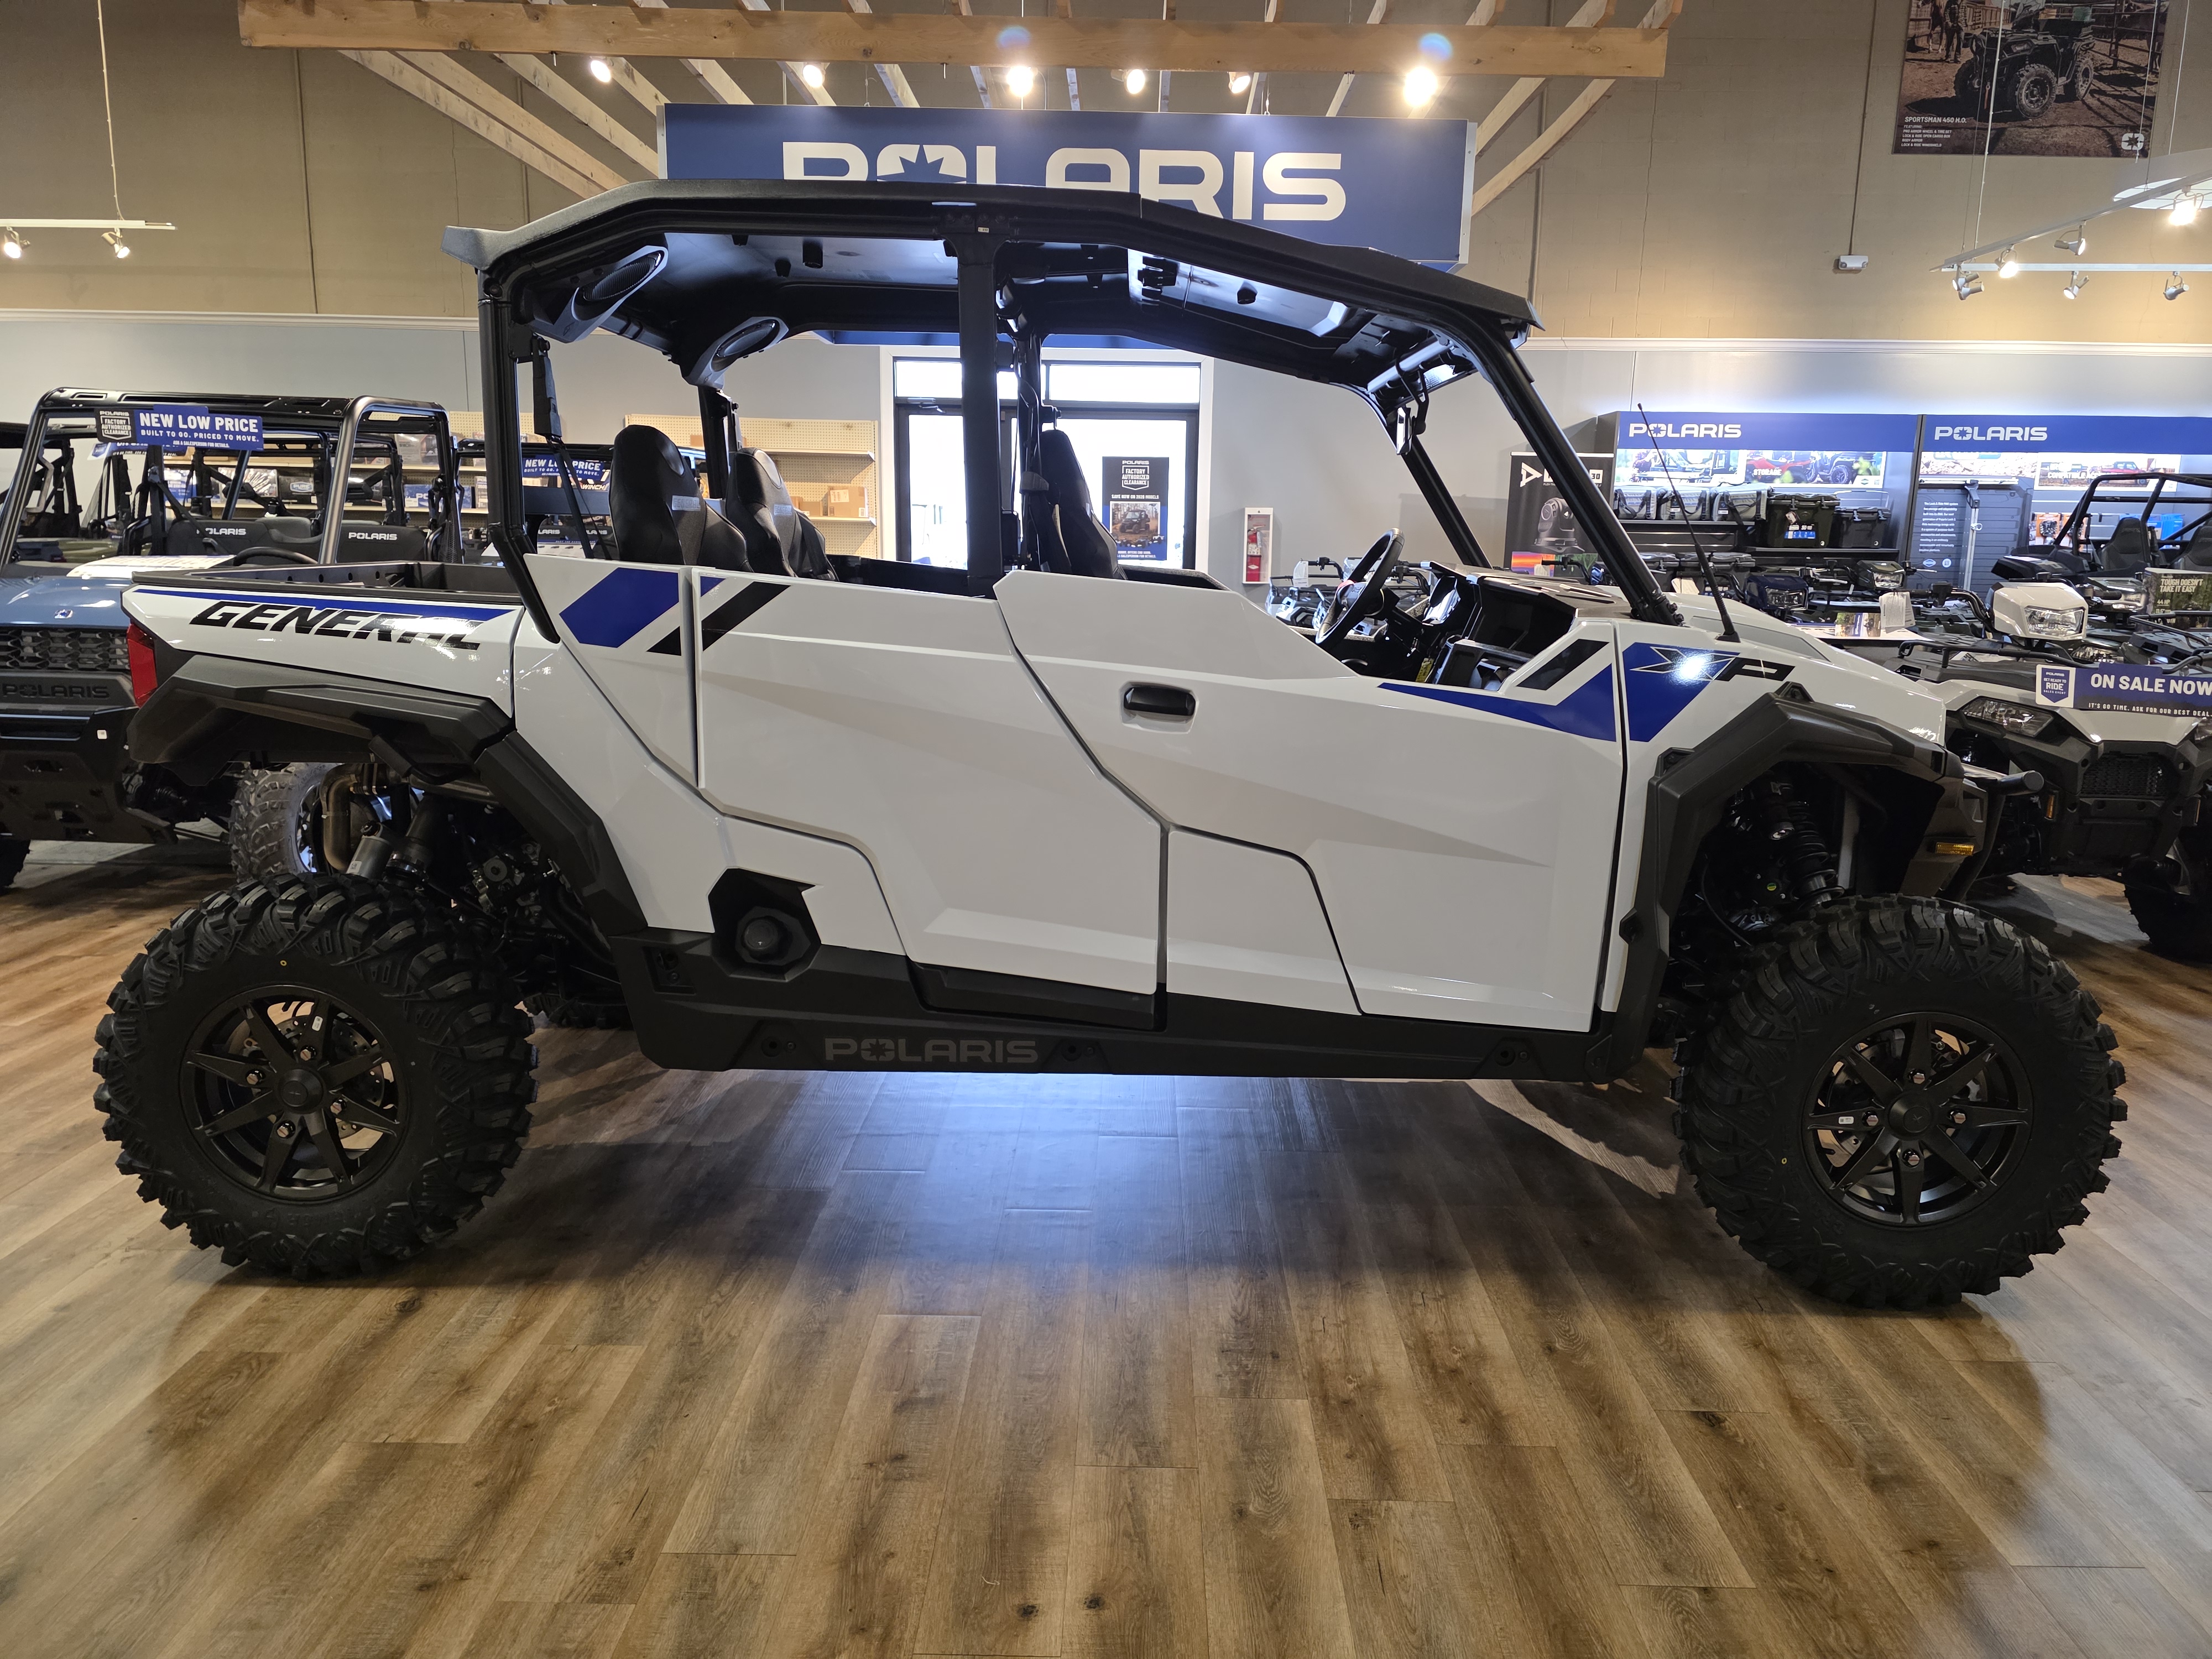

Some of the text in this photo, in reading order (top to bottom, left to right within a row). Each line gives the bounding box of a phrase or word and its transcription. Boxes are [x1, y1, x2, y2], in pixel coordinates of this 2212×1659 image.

[139, 413, 259, 433] NEW LOW PRICE
[1629, 423, 1741, 438] POLARIS
[1934, 426, 2048, 441] POLARIS
[525, 459, 546, 467] NEW
[572, 461, 601, 471] PRICE
[348, 532, 398, 540] POLARIS
[189, 600, 486, 650] GENERAL
[2, 683, 110, 698] POLARIS
[2046, 682, 2064, 691] RIDE
[2090, 674, 2212, 696] ON SALE NOW
[825, 1037, 1039, 1063] POLARIS
